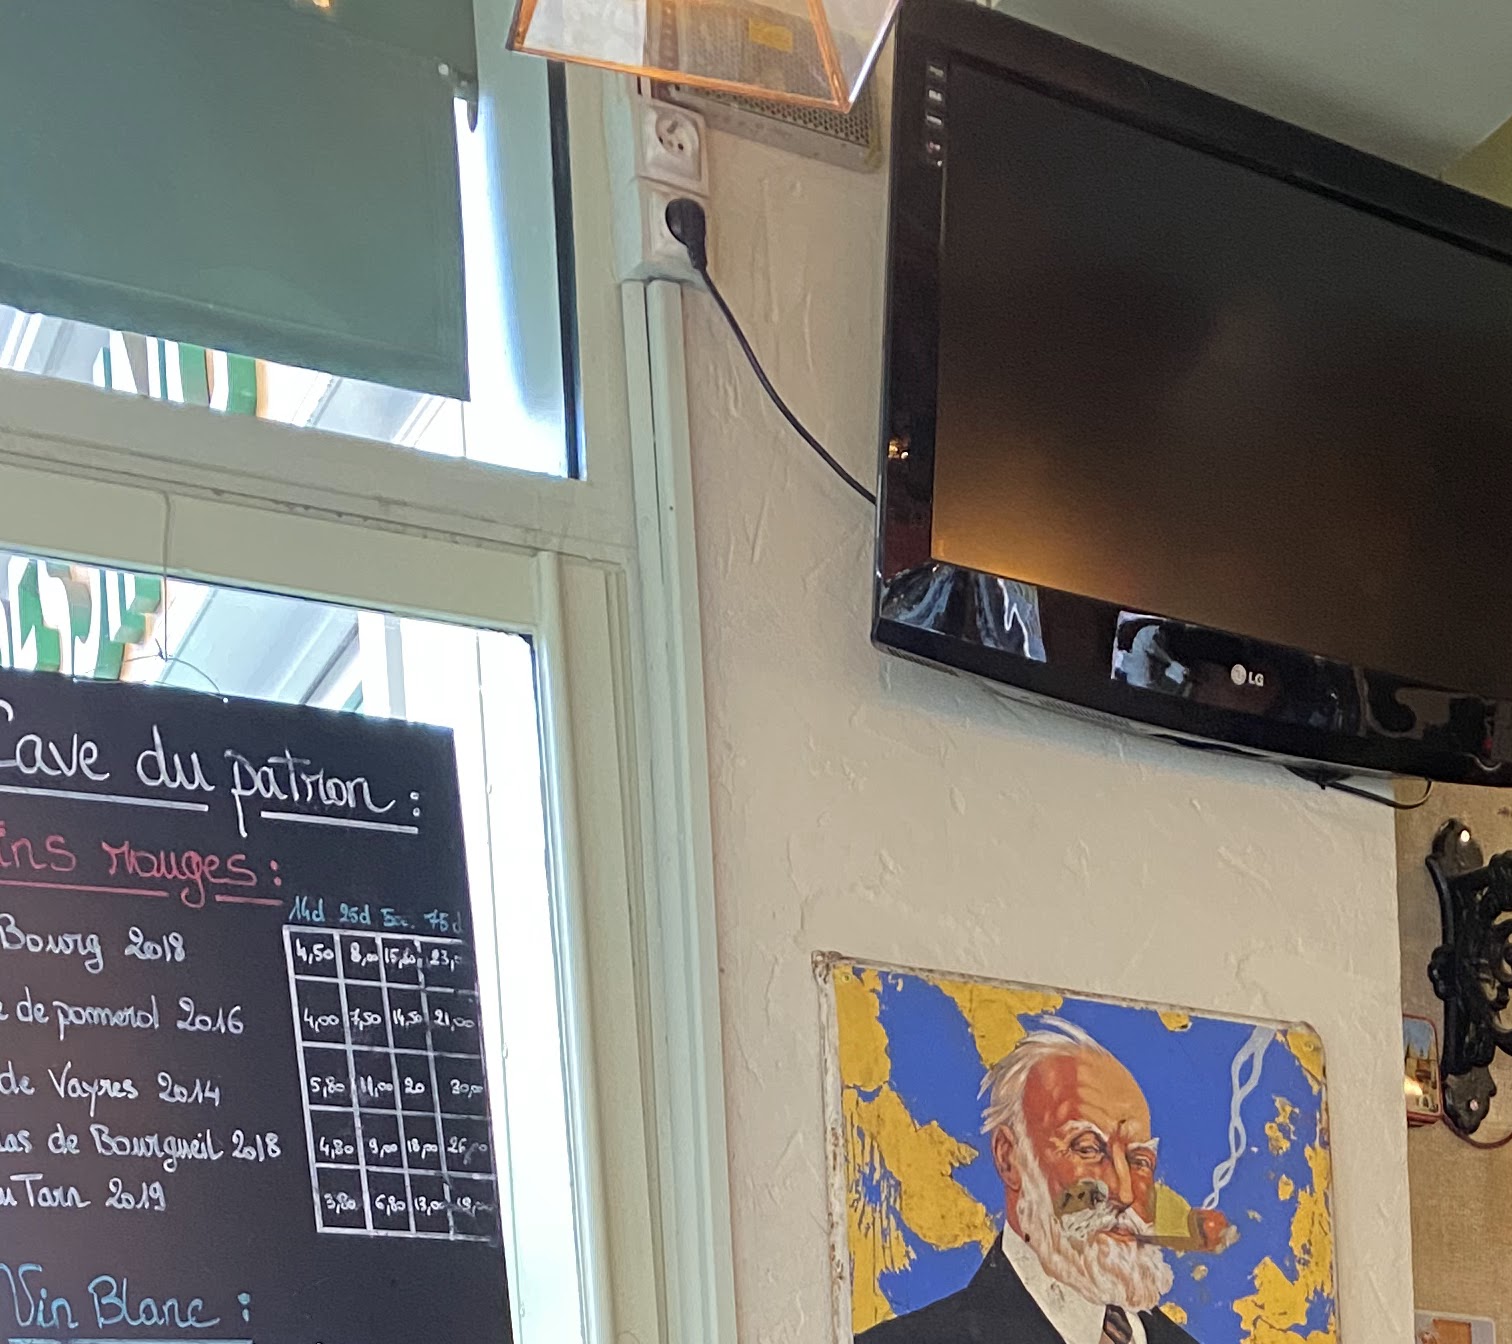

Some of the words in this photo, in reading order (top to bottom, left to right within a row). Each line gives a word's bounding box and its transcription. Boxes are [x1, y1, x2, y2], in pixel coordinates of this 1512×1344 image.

[1248, 671, 1265, 687] LG
[136, 724, 216, 791] du
[224, 746, 396, 838] patron
[101, 840, 258, 909] rouges
[0, 912, 104, 974] Bourg
[124, 926, 187, 962] 2018
[295, 938, 334, 964] 4,50
[350, 942, 379, 966] 8,00
[16, 985, 49, 1024] de
[176, 997, 244, 1034] 2016
[303, 1007, 340, 1032] 4,00
[349, 1008, 382, 1030] 7,50
[392, 1008, 422, 1029] 14,50
[433, 1009, 476, 1031] 21,00
[0, 1060, 35, 1095] de
[157, 1071, 221, 1106] 2014
[309, 1076, 346, 1098] 5,80
[359, 1075, 394, 1098] 11,00
[404, 1076, 426, 1094] 20
[450, 1079, 484, 1098] 30,00
[47, 1122, 81, 1155] de
[89, 1123, 225, 1173] Bourgueil
[231, 1129, 281, 1162] 2018
[319, 1136, 354, 1159] 4,80
[368, 1137, 398, 1158] 9,00
[406, 1137, 438, 1159] 18,00
[10, 1173, 92, 1209] Tarn
[105, 1177, 167, 1212] 2019
[375, 1193, 406, 1216] 6,80
[0, 1262, 79, 1330] Vin
[87, 1275, 221, 1330] Blanc
